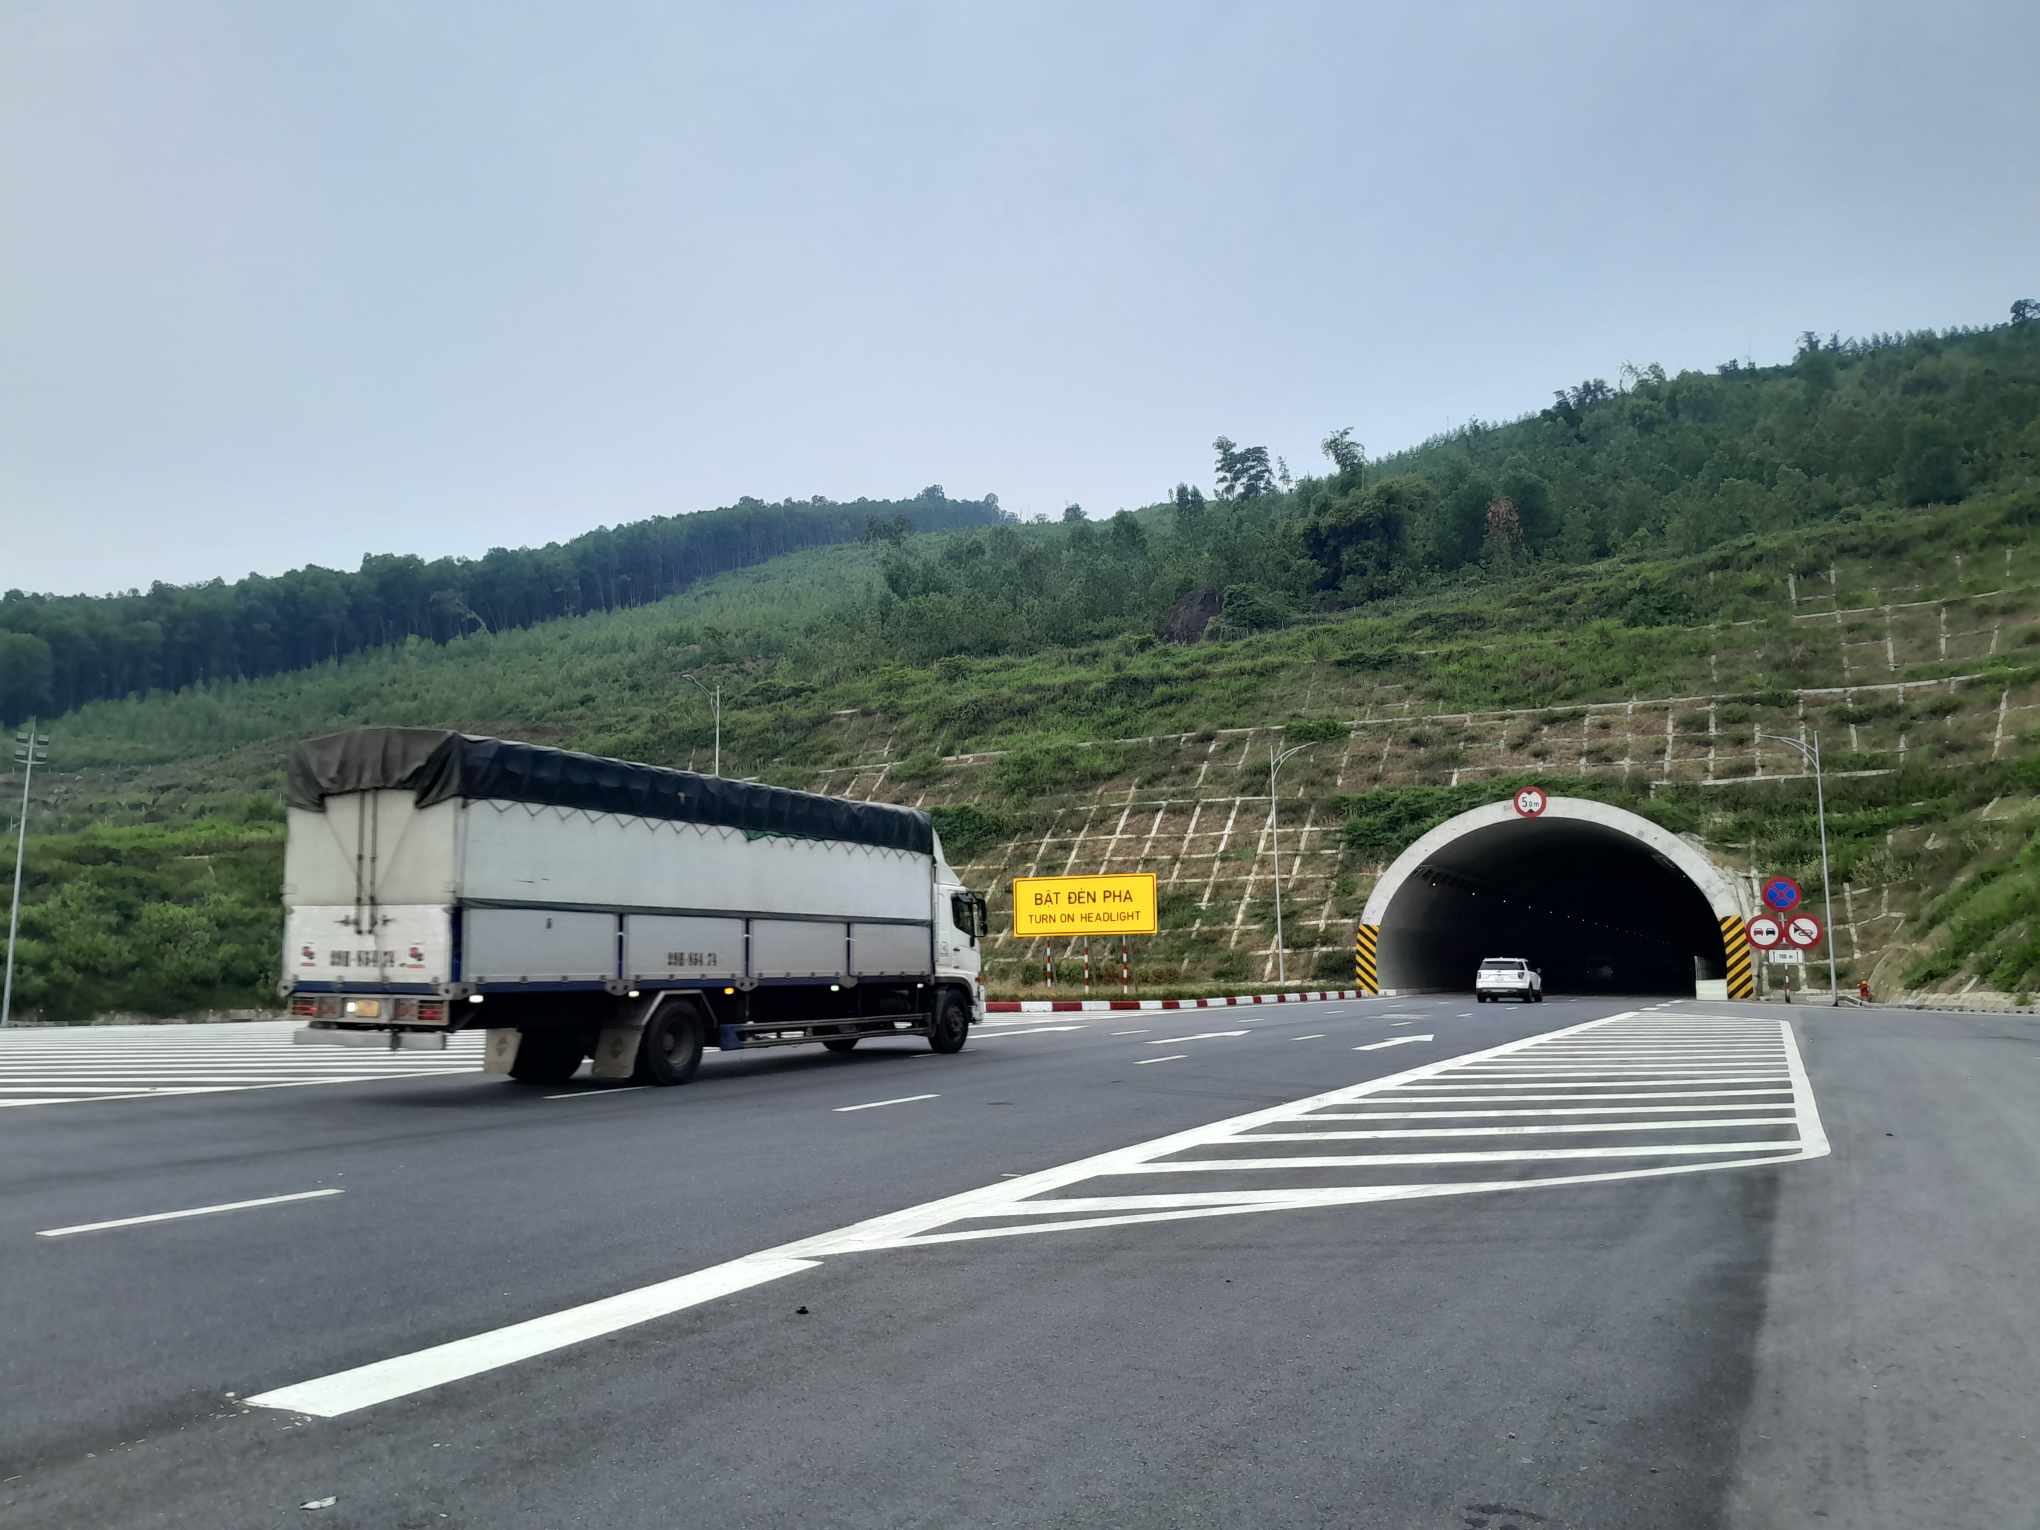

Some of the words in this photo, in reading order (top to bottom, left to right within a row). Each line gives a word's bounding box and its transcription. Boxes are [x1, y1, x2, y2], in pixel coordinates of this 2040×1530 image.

[1103, 889, 1133, 903] PHA
[1029, 913, 1056, 924] TURN
[1060, 912, 1075, 923] ON
[1080, 910, 1141, 923] HEADLIGHT
